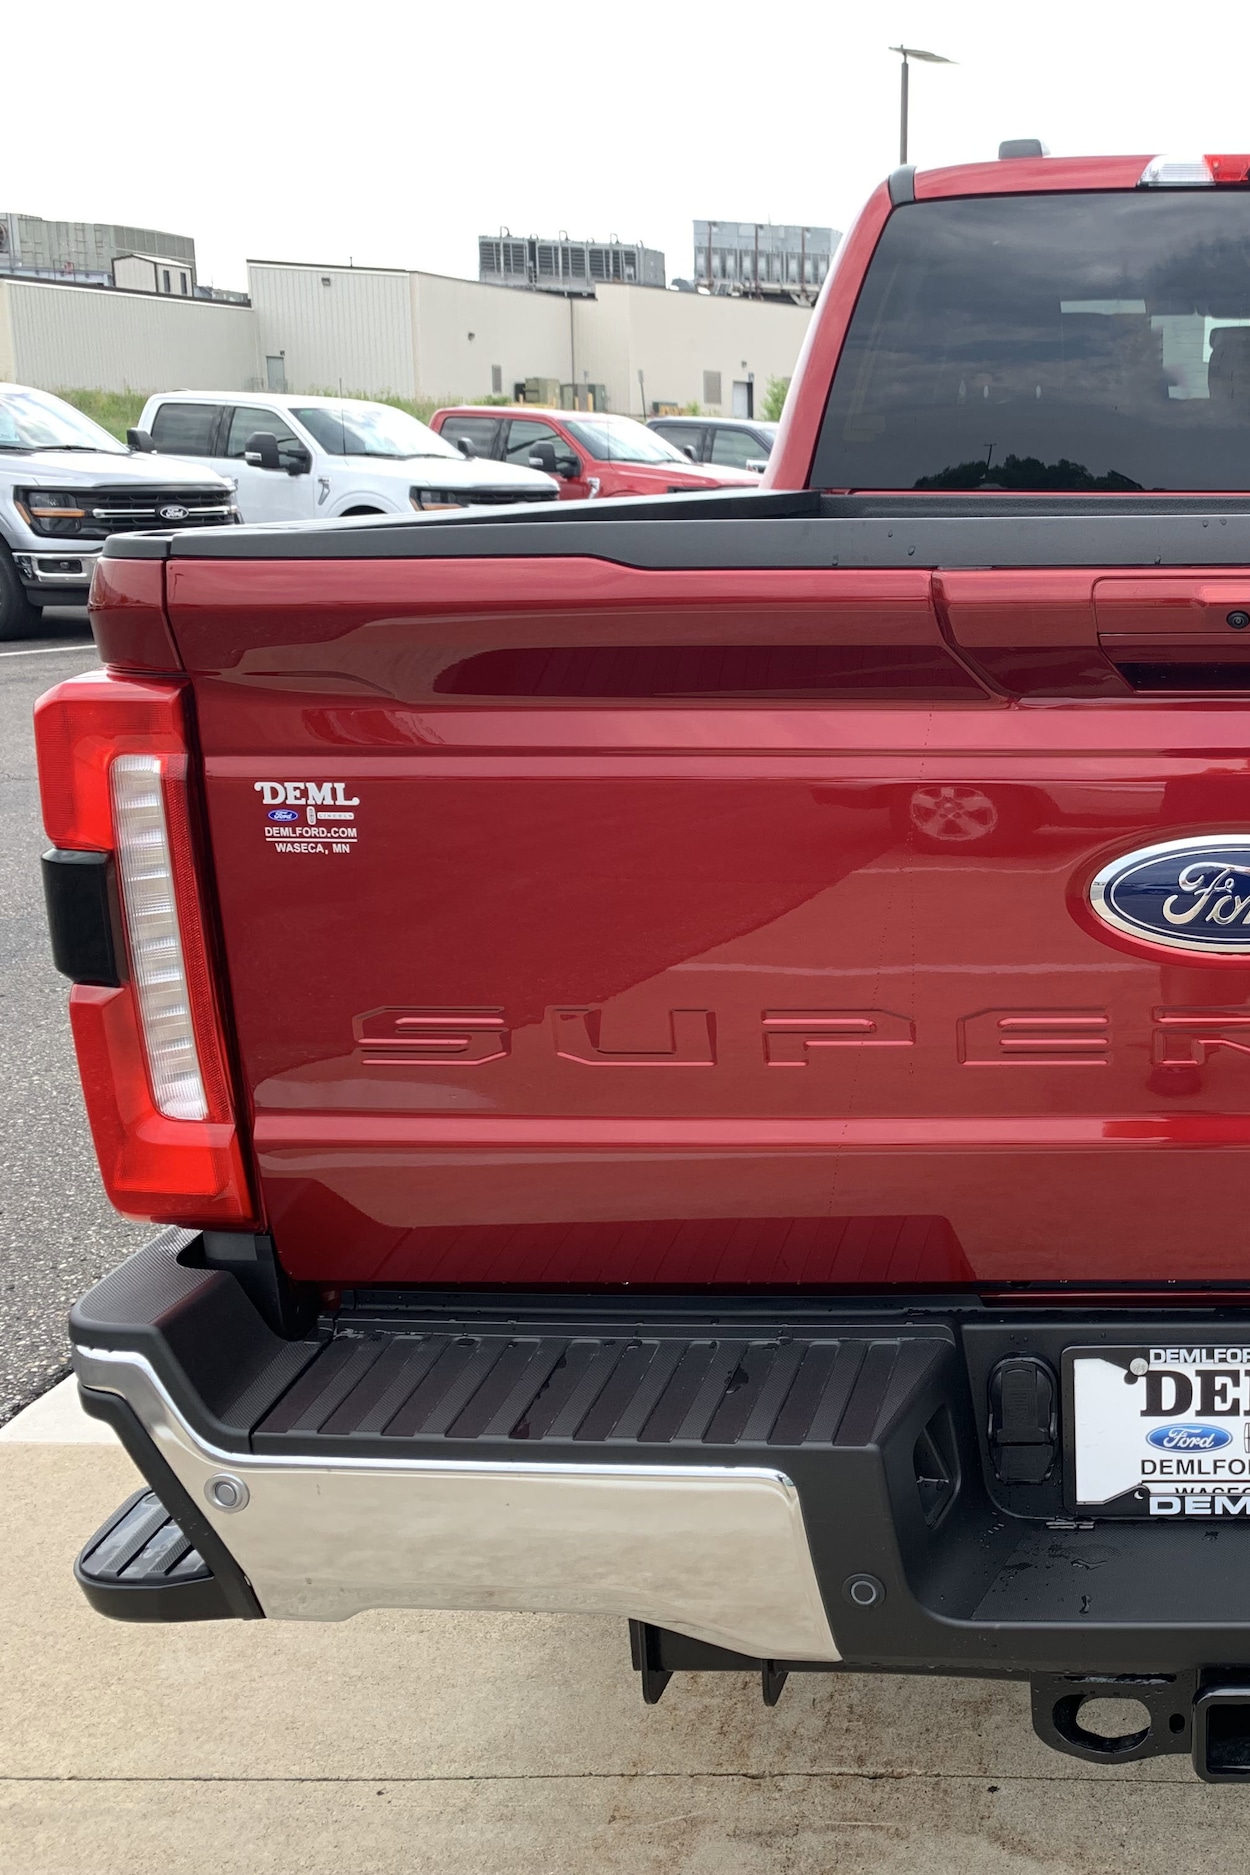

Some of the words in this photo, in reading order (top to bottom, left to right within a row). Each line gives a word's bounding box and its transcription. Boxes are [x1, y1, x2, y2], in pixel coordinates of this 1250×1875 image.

[254, 781, 360, 806] DEML
[264, 827, 358, 838] DEMLFORD.COM
[275, 842, 329, 855] WASECA,
[332, 843, 350, 854] MN
[1162, 1426, 1216, 1449] Ford
